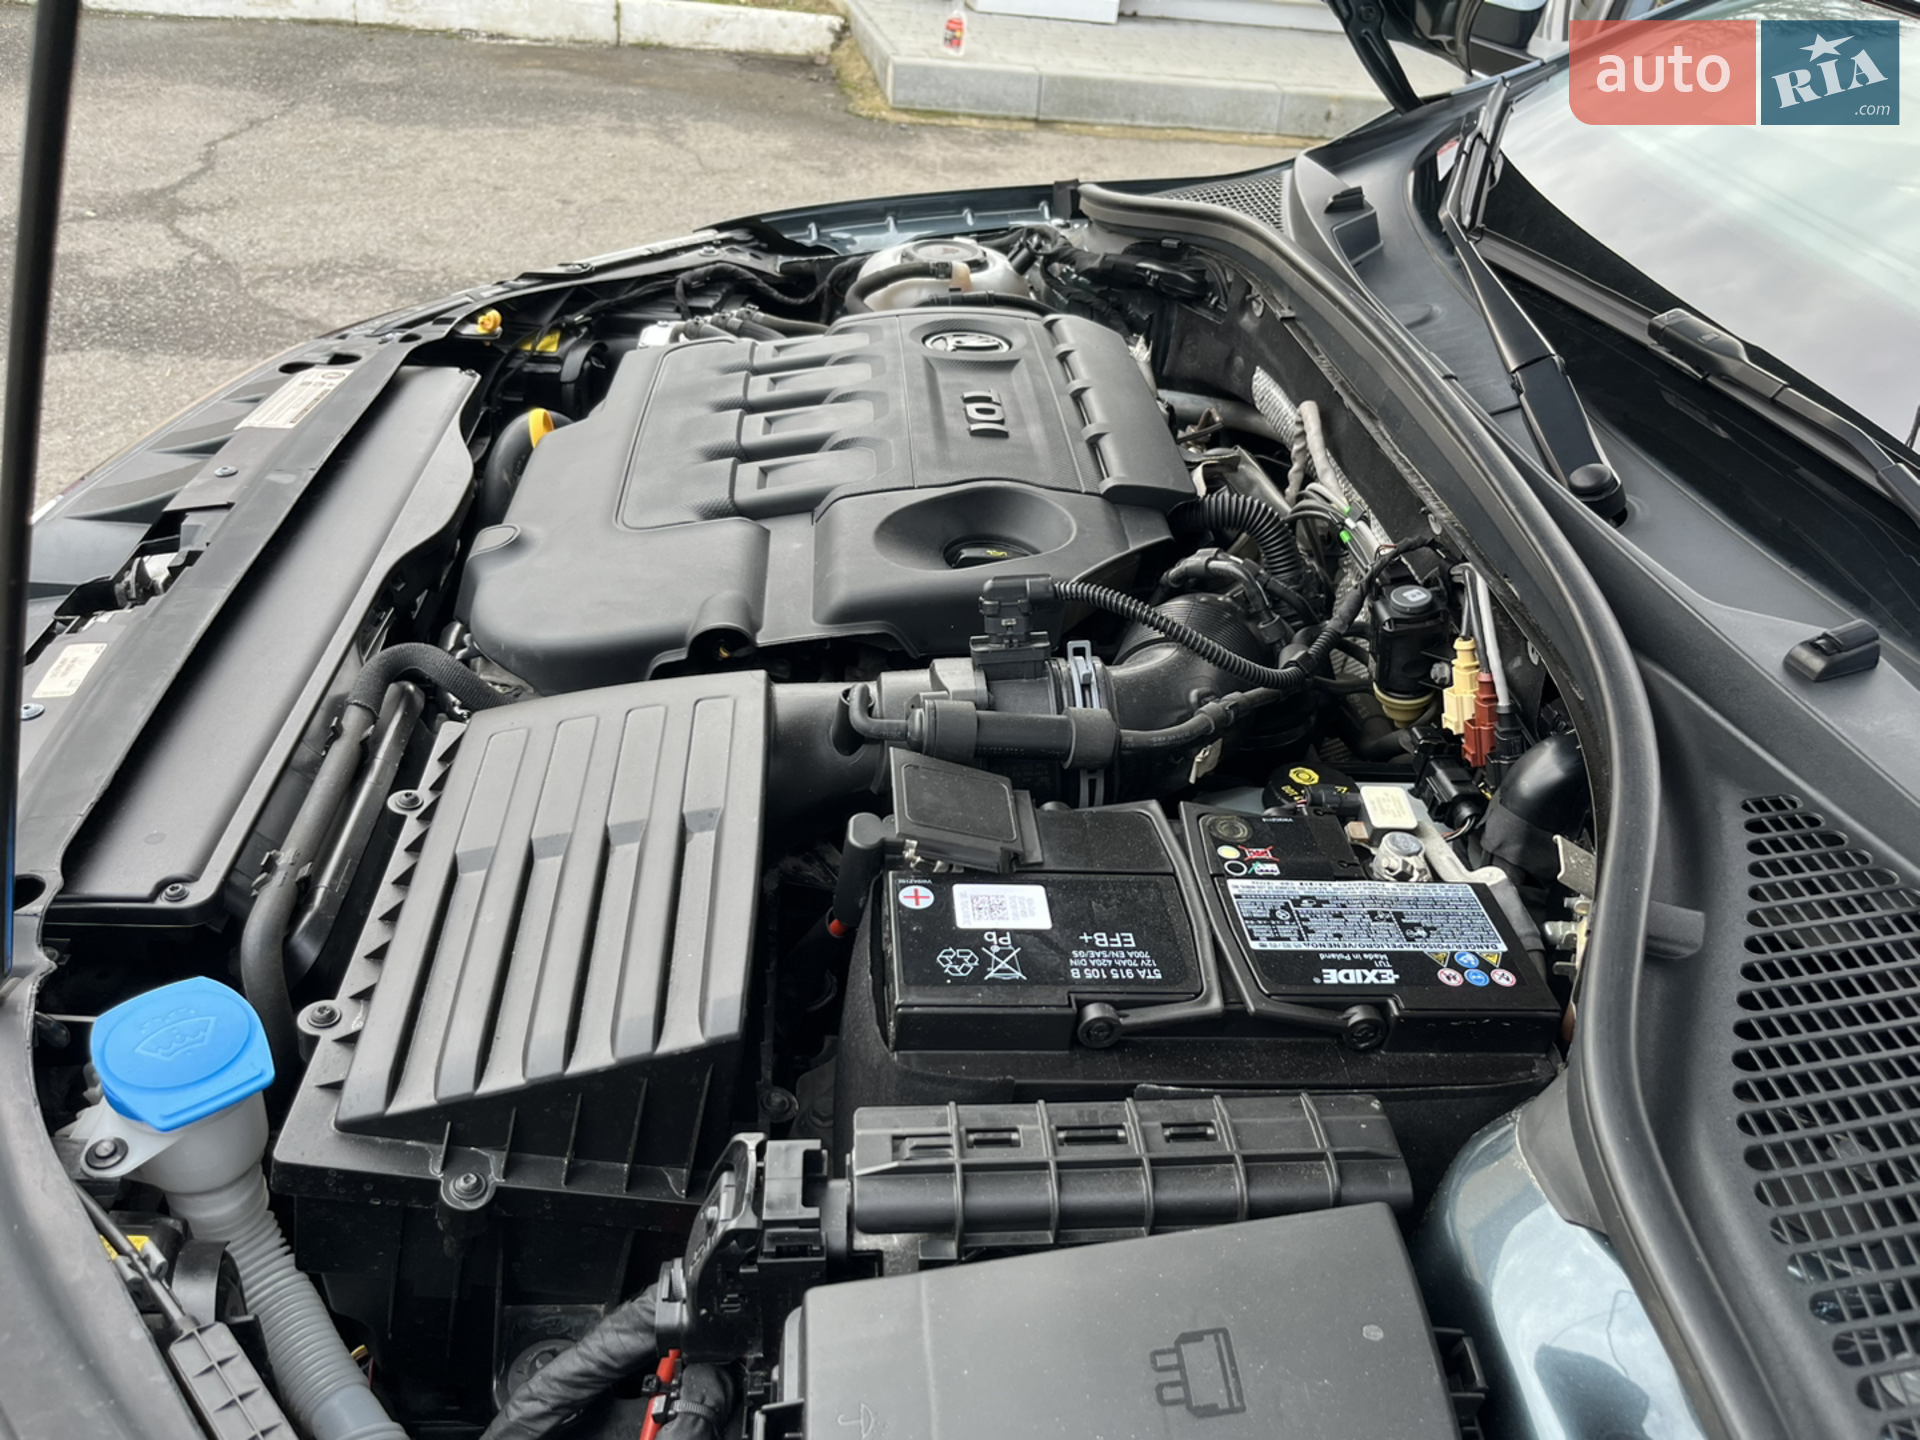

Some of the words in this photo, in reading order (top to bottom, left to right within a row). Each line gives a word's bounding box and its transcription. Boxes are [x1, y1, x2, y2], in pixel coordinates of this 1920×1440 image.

[961, 388, 1009, 438] TDI
[983, 931, 1012, 945] Pb
[1078, 931, 1136, 947] EFB+
[1070, 968, 1081, 979] B
[1083, 968, 1107, 979] 105
[1110, 968, 1134, 979] 915
[1136, 968, 1163, 979] 5TA
[1321, 968, 1398, 984] EXIDE
